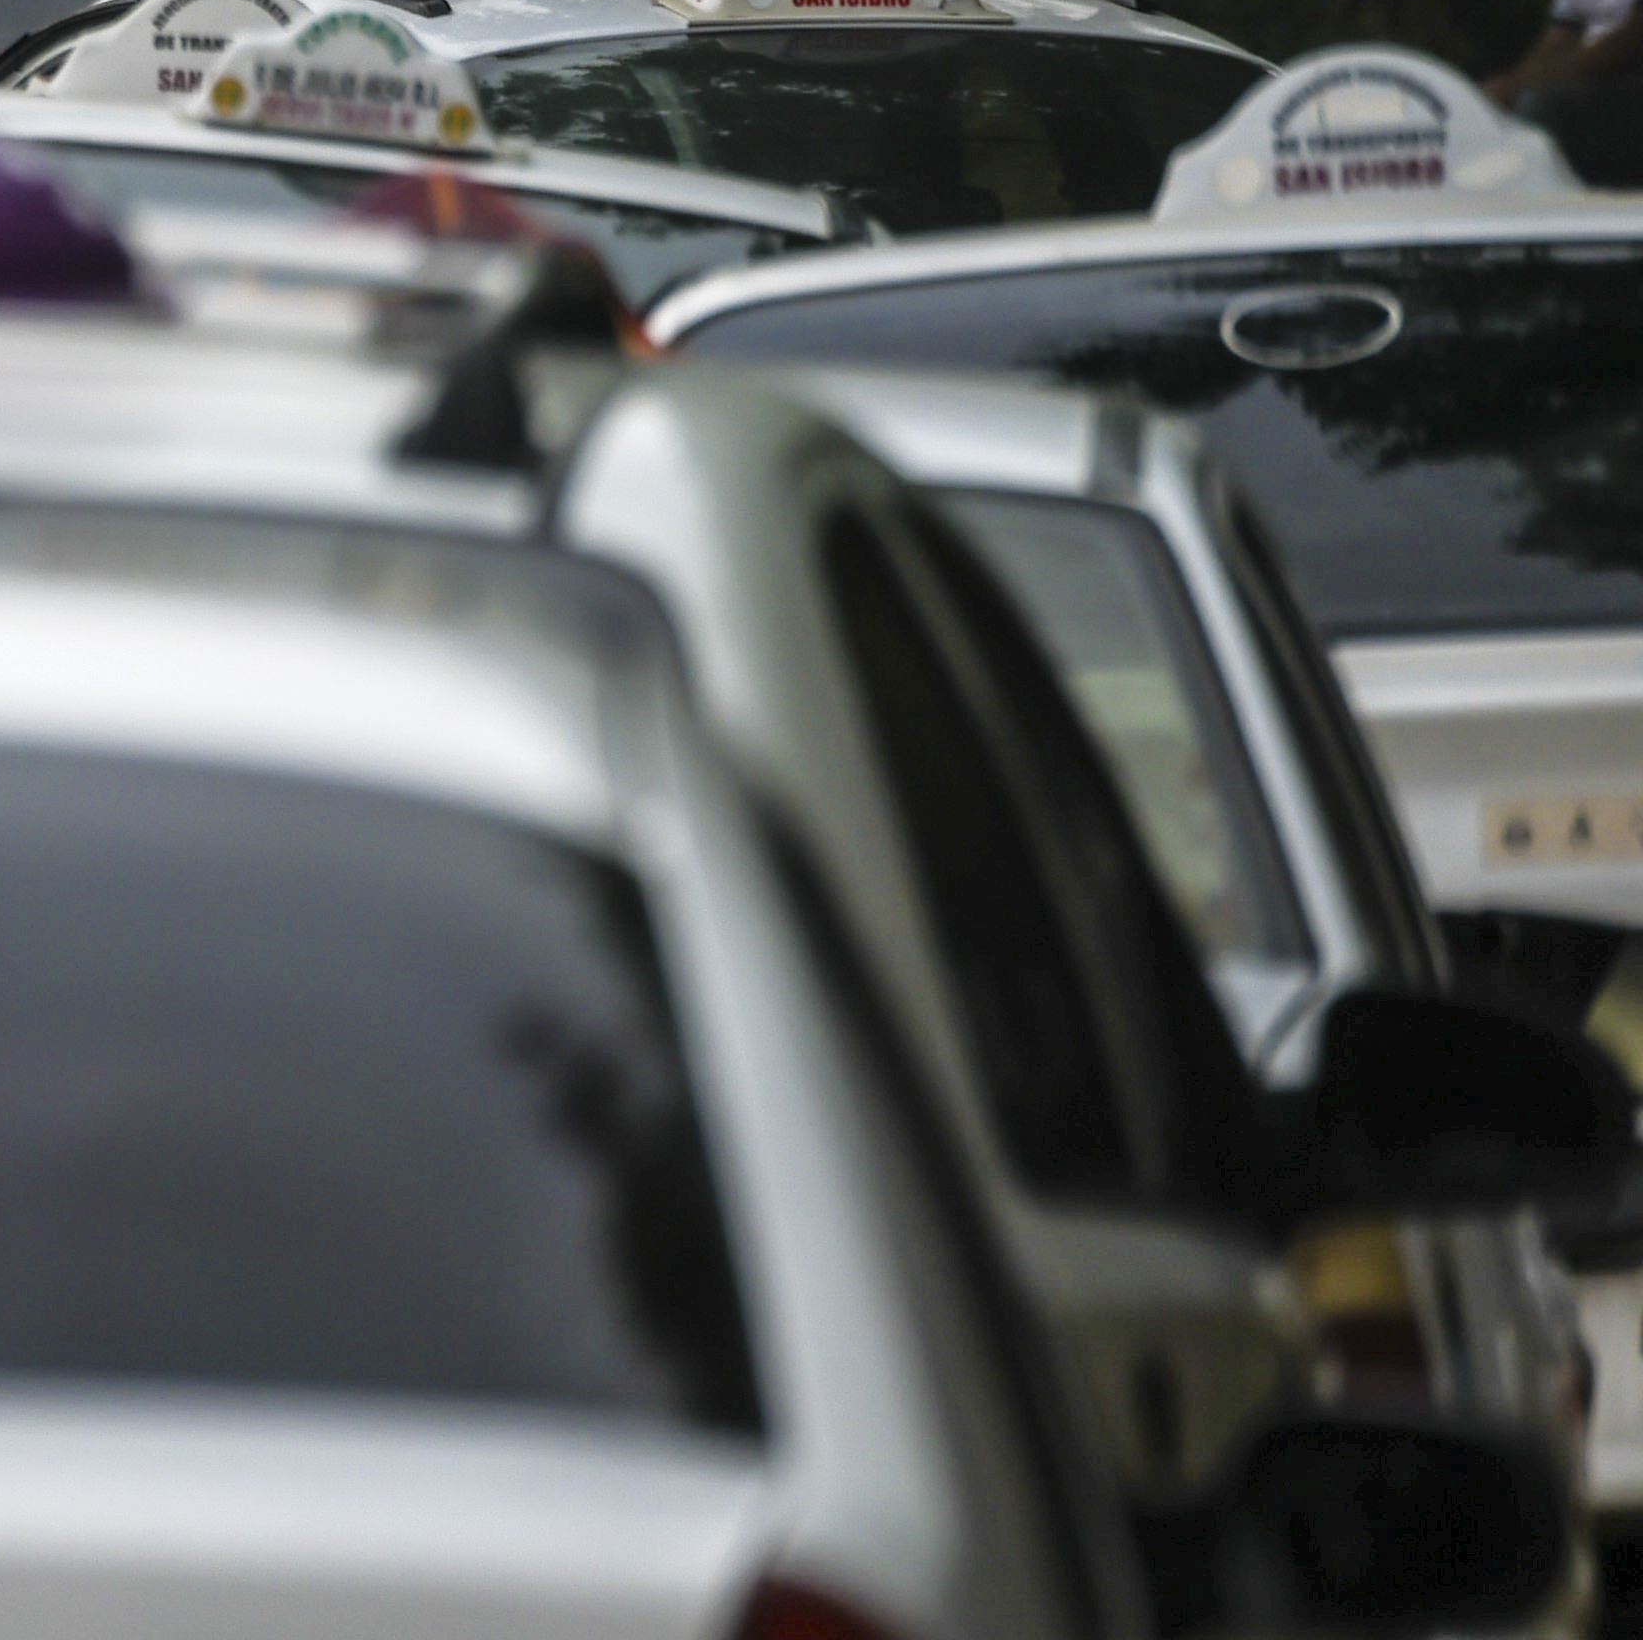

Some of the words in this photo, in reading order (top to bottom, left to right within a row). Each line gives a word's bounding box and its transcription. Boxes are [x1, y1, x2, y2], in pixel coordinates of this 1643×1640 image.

[154, 34, 175, 51] DE
[180, 34, 230, 52] TRAN
[158, 67, 203, 93] SAN
[1274, 163, 1331, 196] SAN
[1340, 156, 1446, 193] ISIDRO
